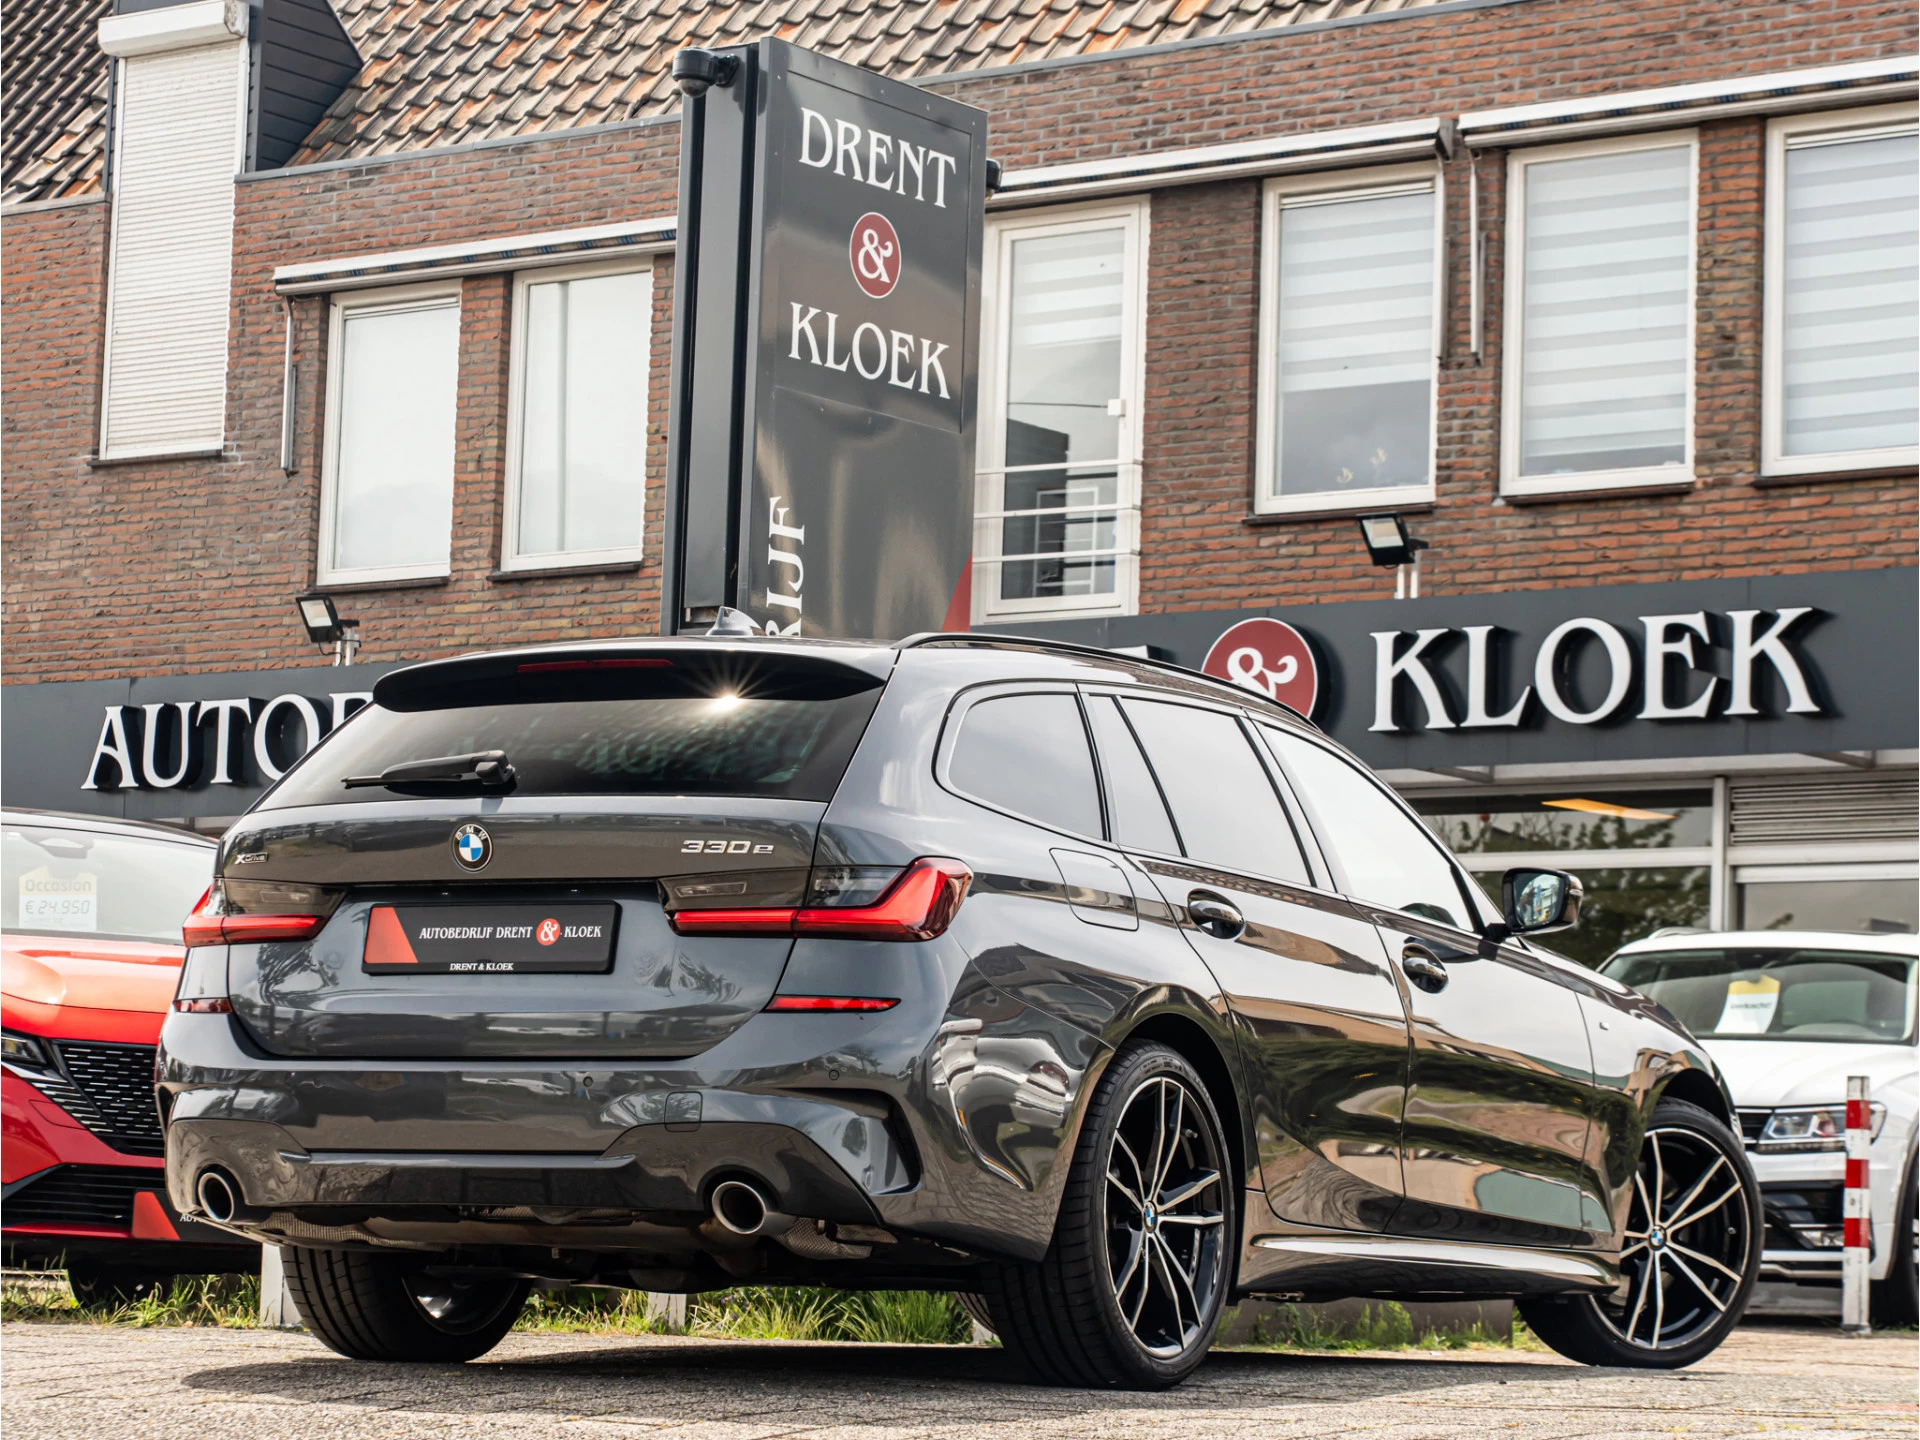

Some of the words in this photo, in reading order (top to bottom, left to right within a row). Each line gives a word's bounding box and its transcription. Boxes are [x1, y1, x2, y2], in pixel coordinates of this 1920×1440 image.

[799, 107, 956, 208] DRENT
[857, 229, 893, 284] &
[788, 301, 950, 399] KLOEK
[1368, 607, 1821, 732] KLOEK
[455, 825, 488, 841] BMW
[681, 840, 775, 854] 330e
[25, 879, 92, 892] Occasion
[25, 900, 35, 915] €
[419, 927, 493, 939] AUTOBEDRIJF
[496, 926, 533, 939] DRENT
[540, 921, 558, 942] &
[564, 926, 602, 938] KLOEK
[449, 963, 477, 971] DRENT
[478, 963, 485, 971] &
[486, 963, 514, 971] KLOEK
